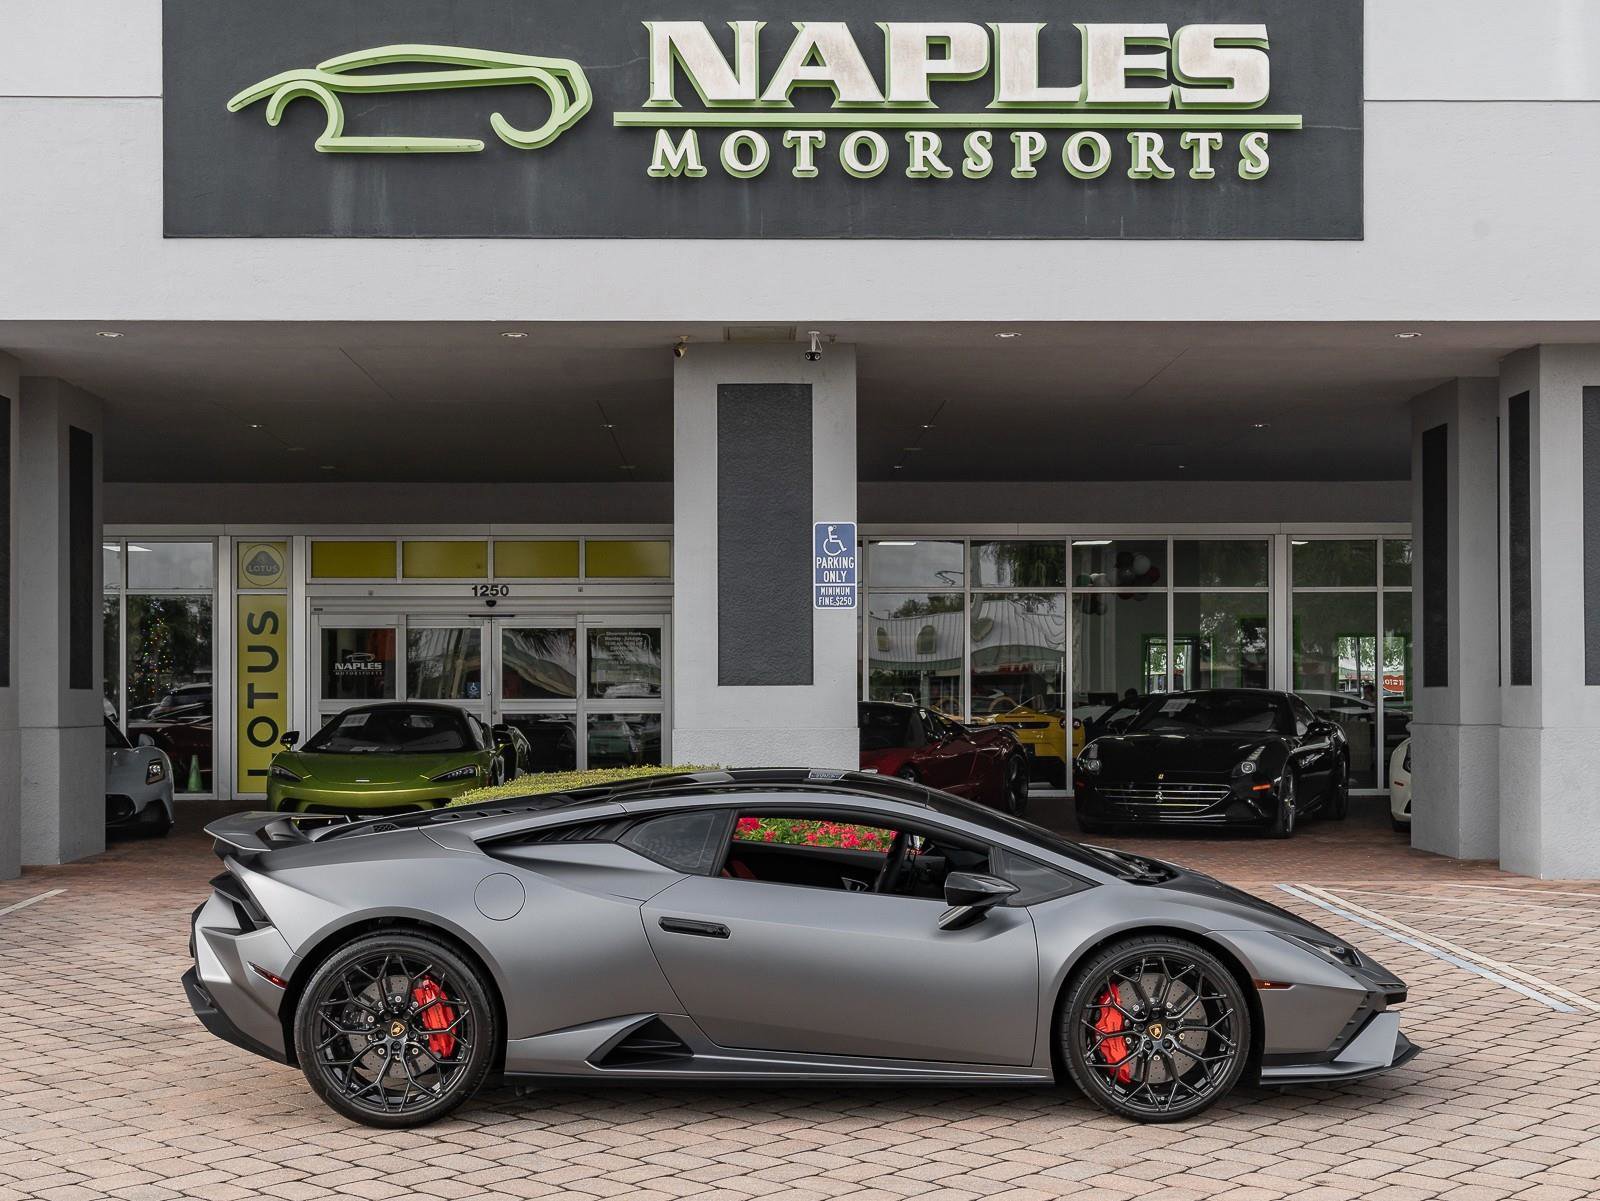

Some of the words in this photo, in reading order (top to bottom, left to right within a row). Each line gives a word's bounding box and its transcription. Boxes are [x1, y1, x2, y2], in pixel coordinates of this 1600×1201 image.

[642, 20, 1271, 109] NAPLES
[647, 128, 1270, 180] MOTORSPORTS
[816, 556, 855, 569] PARKING
[248, 564, 278, 574] LOTUS
[823, 570, 847, 583] ONLY
[471, 585, 510, 597] 1250
[820, 586, 851, 596] MINIMUM
[818, 596, 834, 606] FINE
[835, 596, 852, 606] $250
[334, 662, 382, 670] NAPLES
